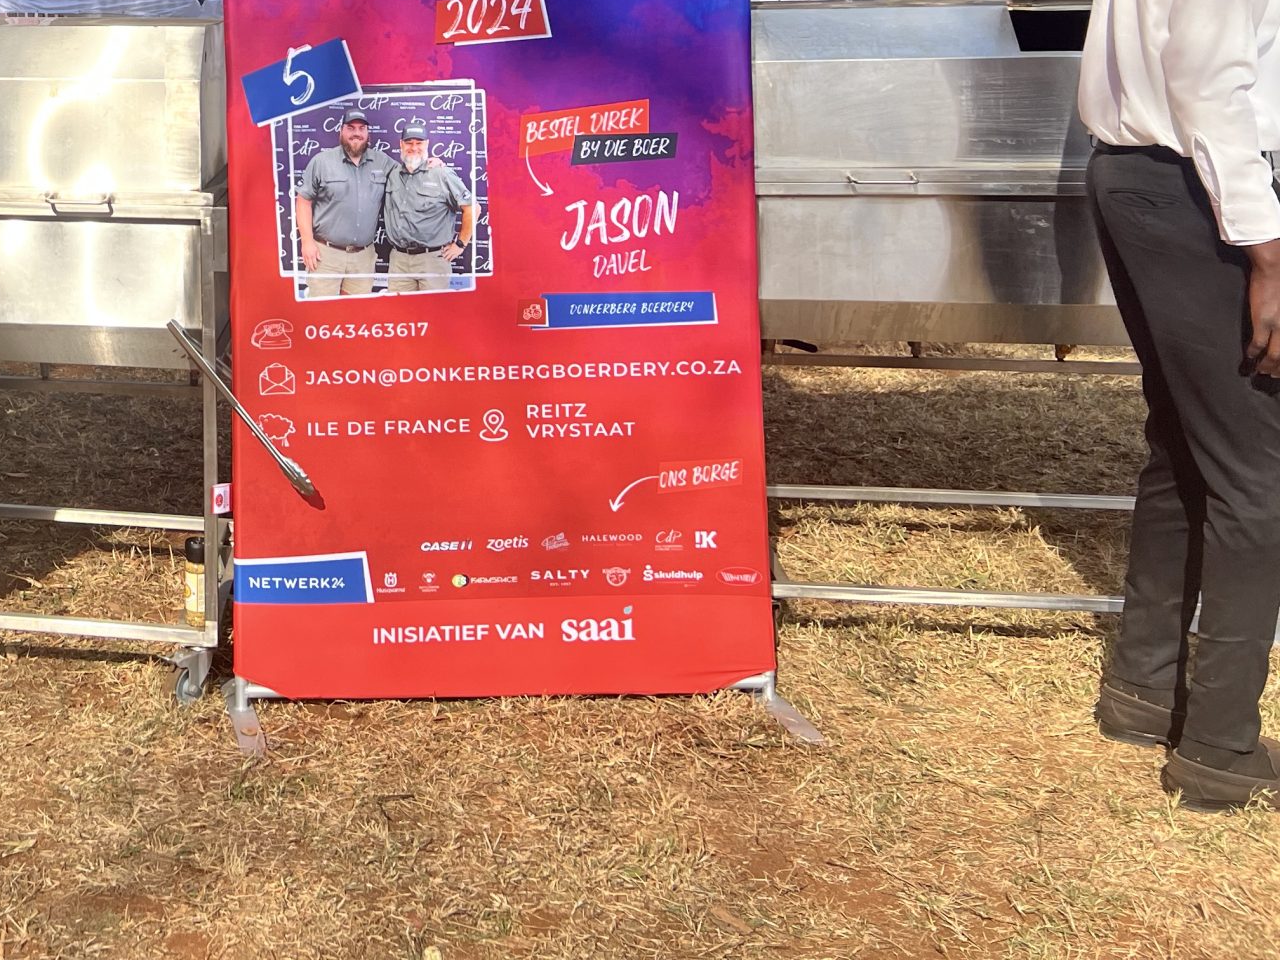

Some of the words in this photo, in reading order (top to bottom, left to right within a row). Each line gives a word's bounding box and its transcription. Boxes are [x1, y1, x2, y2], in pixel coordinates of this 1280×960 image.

[282, 45, 316, 106] 5
[526, 116, 585, 143] BESTEL
[590, 107, 644, 134] DIREK
[580, 139, 600, 159] BY
[604, 139, 629, 157] DIE
[633, 137, 670, 156] BOER
[560, 190, 679, 251] JASON
[593, 249, 652, 279] DAVEL
[569, 302, 637, 316] DONKERBERG
[640, 301, 695, 314] BOERDERY
[305, 322, 429, 340] 0643463617
[305, 359, 742, 387] JASON@DONKERBERGBOERDERY.CO.ZA
[526, 403, 587, 419] REITZ
[307, 422, 338, 437] ILE
[347, 421, 376, 436] DE
[384, 418, 470, 435] FRANCE
[526, 421, 635, 438] VRYSTAAT
[659, 469, 687, 488] ONS
[692, 460, 740, 485] BORGE
[421, 541, 458, 552] CASE
[486, 534, 529, 552] zoetis
[581, 533, 643, 542] HALEWOOD
[248, 576, 345, 589] NETWERK24
[530, 569, 590, 580] SALTY
[654, 570, 704, 581] skuldhulp
[373, 623, 489, 645] INISIATIEF
[495, 622, 545, 640] VAN
[561, 605, 636, 642] saai
